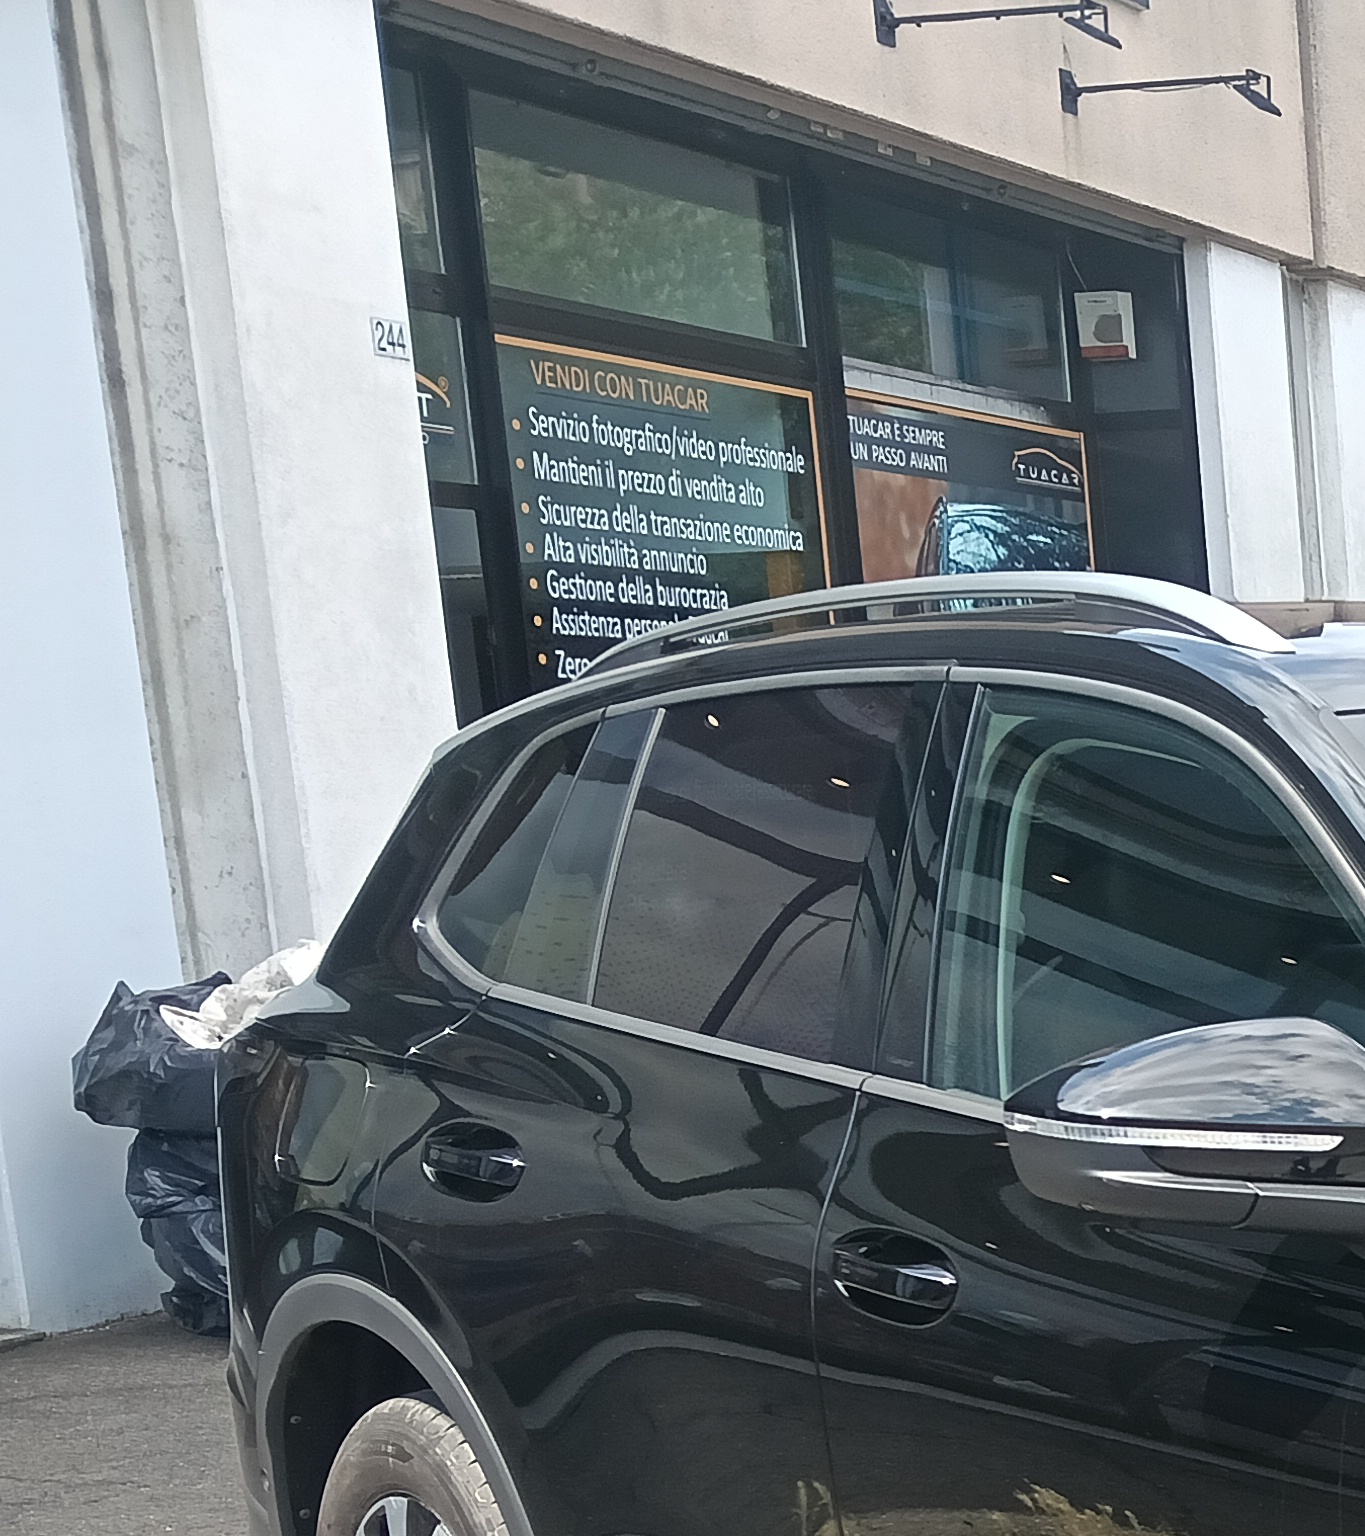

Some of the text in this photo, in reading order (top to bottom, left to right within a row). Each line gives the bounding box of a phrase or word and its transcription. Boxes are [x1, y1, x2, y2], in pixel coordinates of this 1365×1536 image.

[375, 320, 407, 355] 244
[530, 359, 709, 413] VENDI CON TUACAR
[528, 406, 805, 474] Servizio fotografico/video professionale
[847, 415, 946, 449] TUACAR È SEMPRE
[850, 441, 948, 473] UN PASSO AVANTI
[1017, 463, 1080, 486] TUACAR
[532, 451, 764, 507] Mantieni il prezzo di vendita alto
[538, 495, 804, 551] Sicurezza della transazione economica
[544, 532, 707, 575] Alta visibilità annuncio
[546, 570, 728, 610] Gestione della burocrazia
[552, 607, 622, 639] Assistenza
